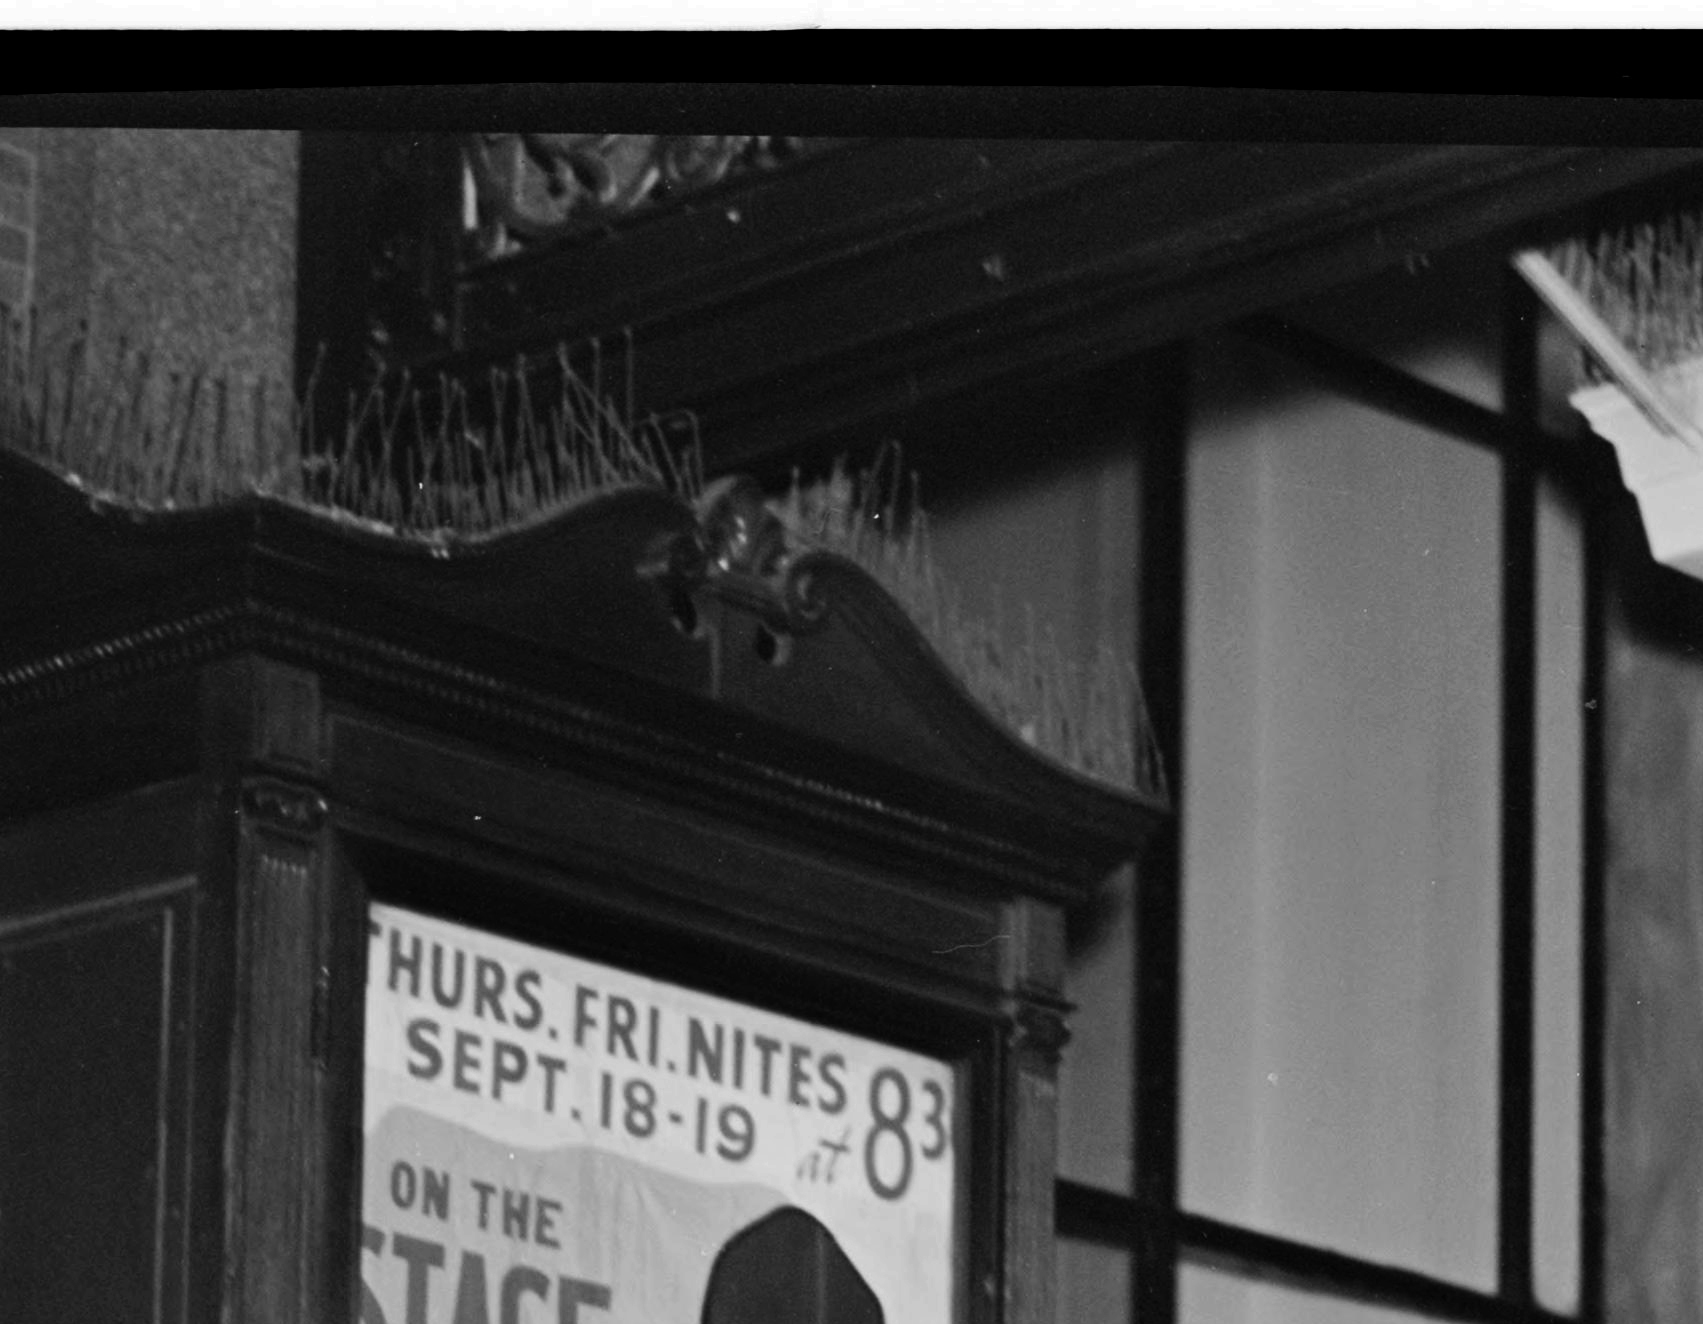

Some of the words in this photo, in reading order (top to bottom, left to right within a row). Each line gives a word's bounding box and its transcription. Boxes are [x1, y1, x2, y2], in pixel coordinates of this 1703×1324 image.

[369, 918, 557, 1041] HURS.
[405, 1017, 582, 1121] SEPT.
[600, 1071, 755, 1162] 18-19
[390, 1160, 450, 1221] ON
[470, 1178, 563, 1250] THE
